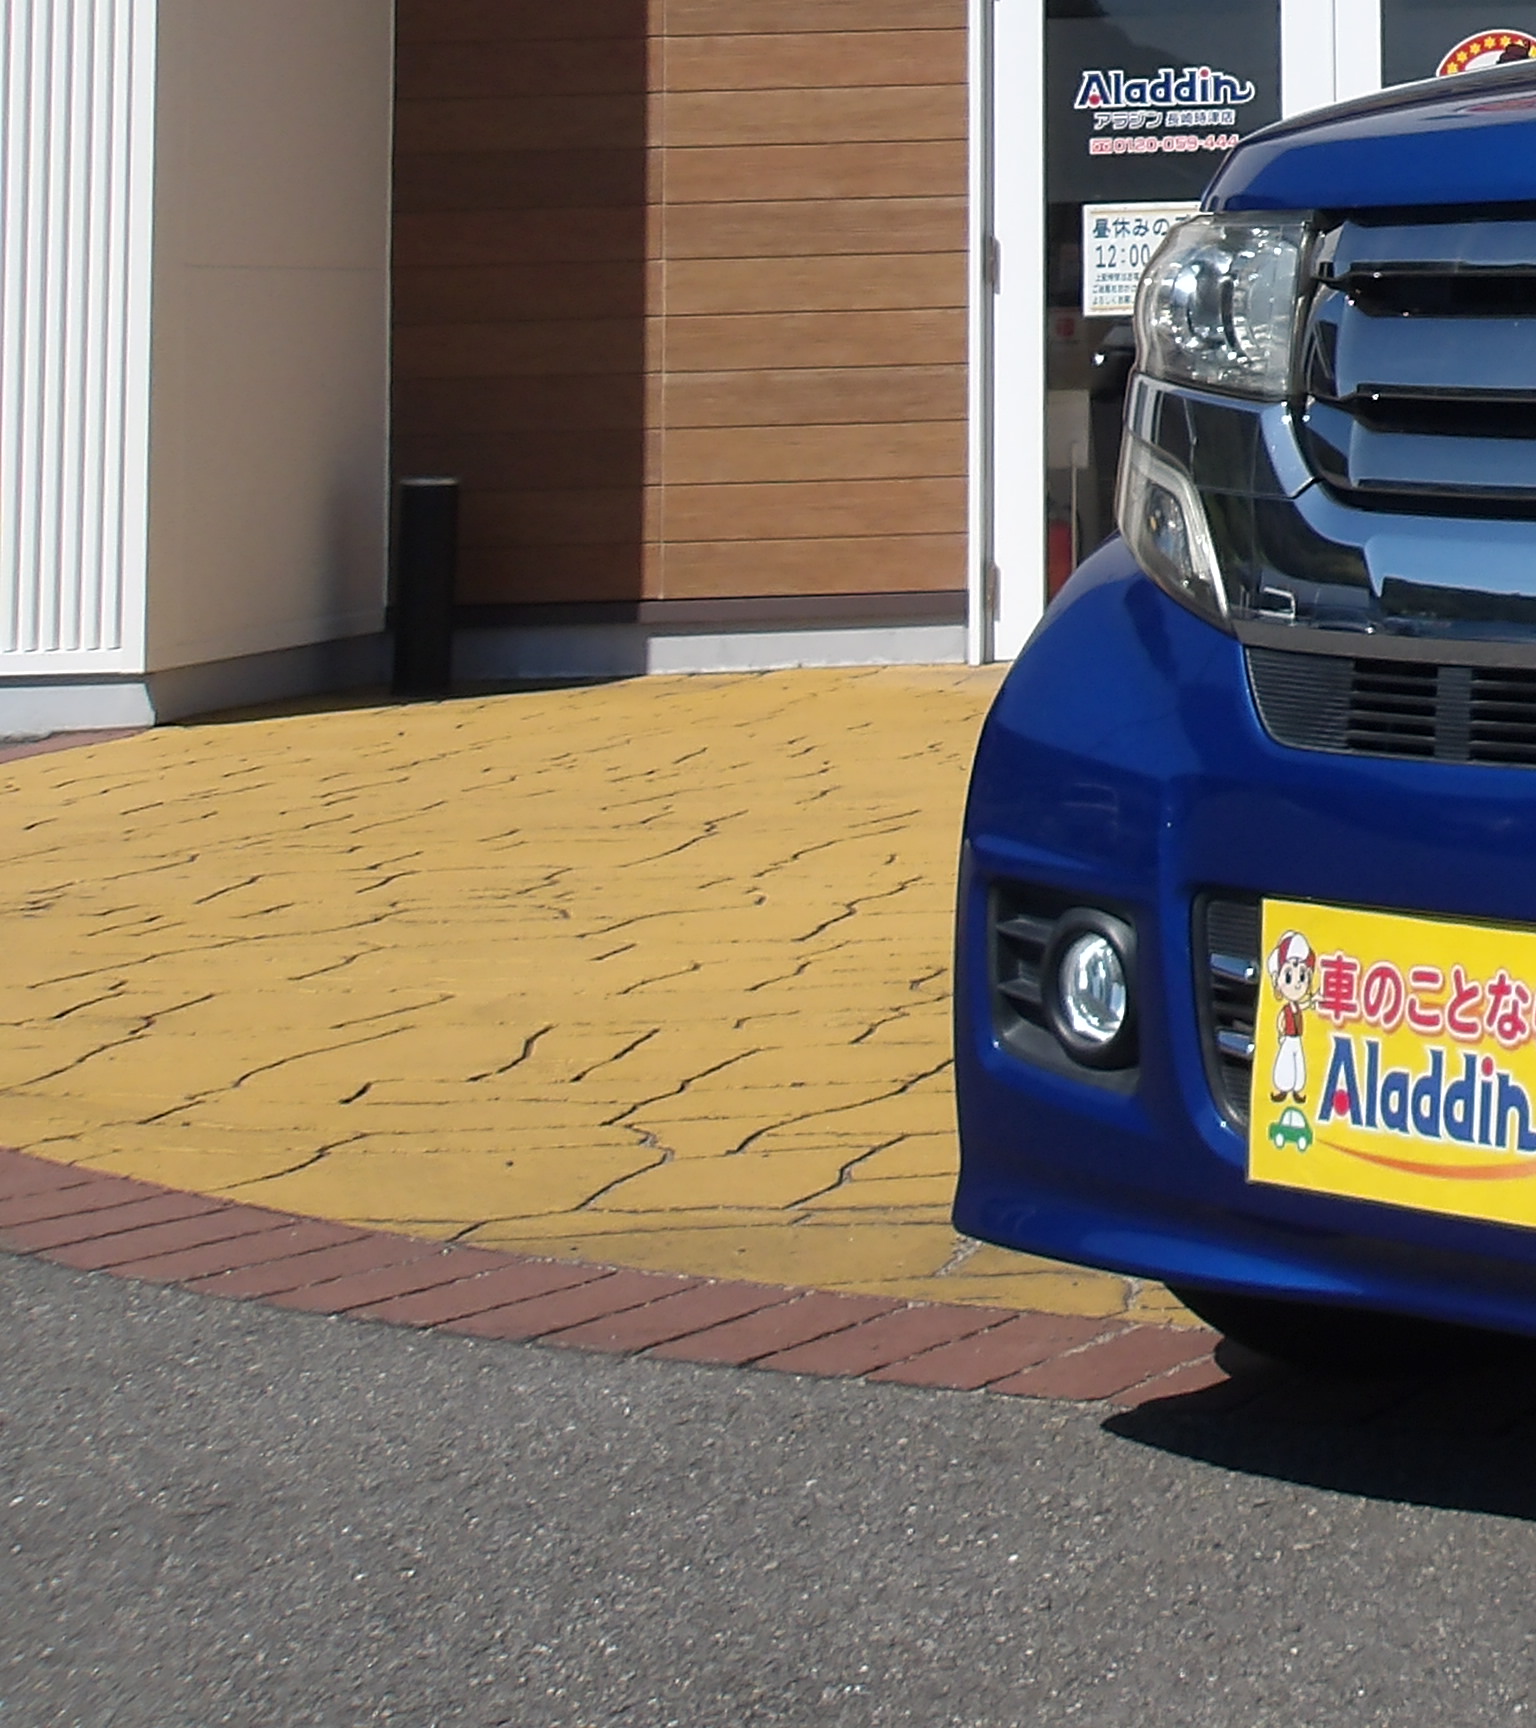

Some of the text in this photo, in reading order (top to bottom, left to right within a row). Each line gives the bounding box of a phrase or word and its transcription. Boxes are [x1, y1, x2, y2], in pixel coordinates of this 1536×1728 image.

[1074, 66, 1255, 109] Aladdin
[1094, 110, 1163, 130] アラジン
[1092, 214, 1191, 239] 昼休みの
